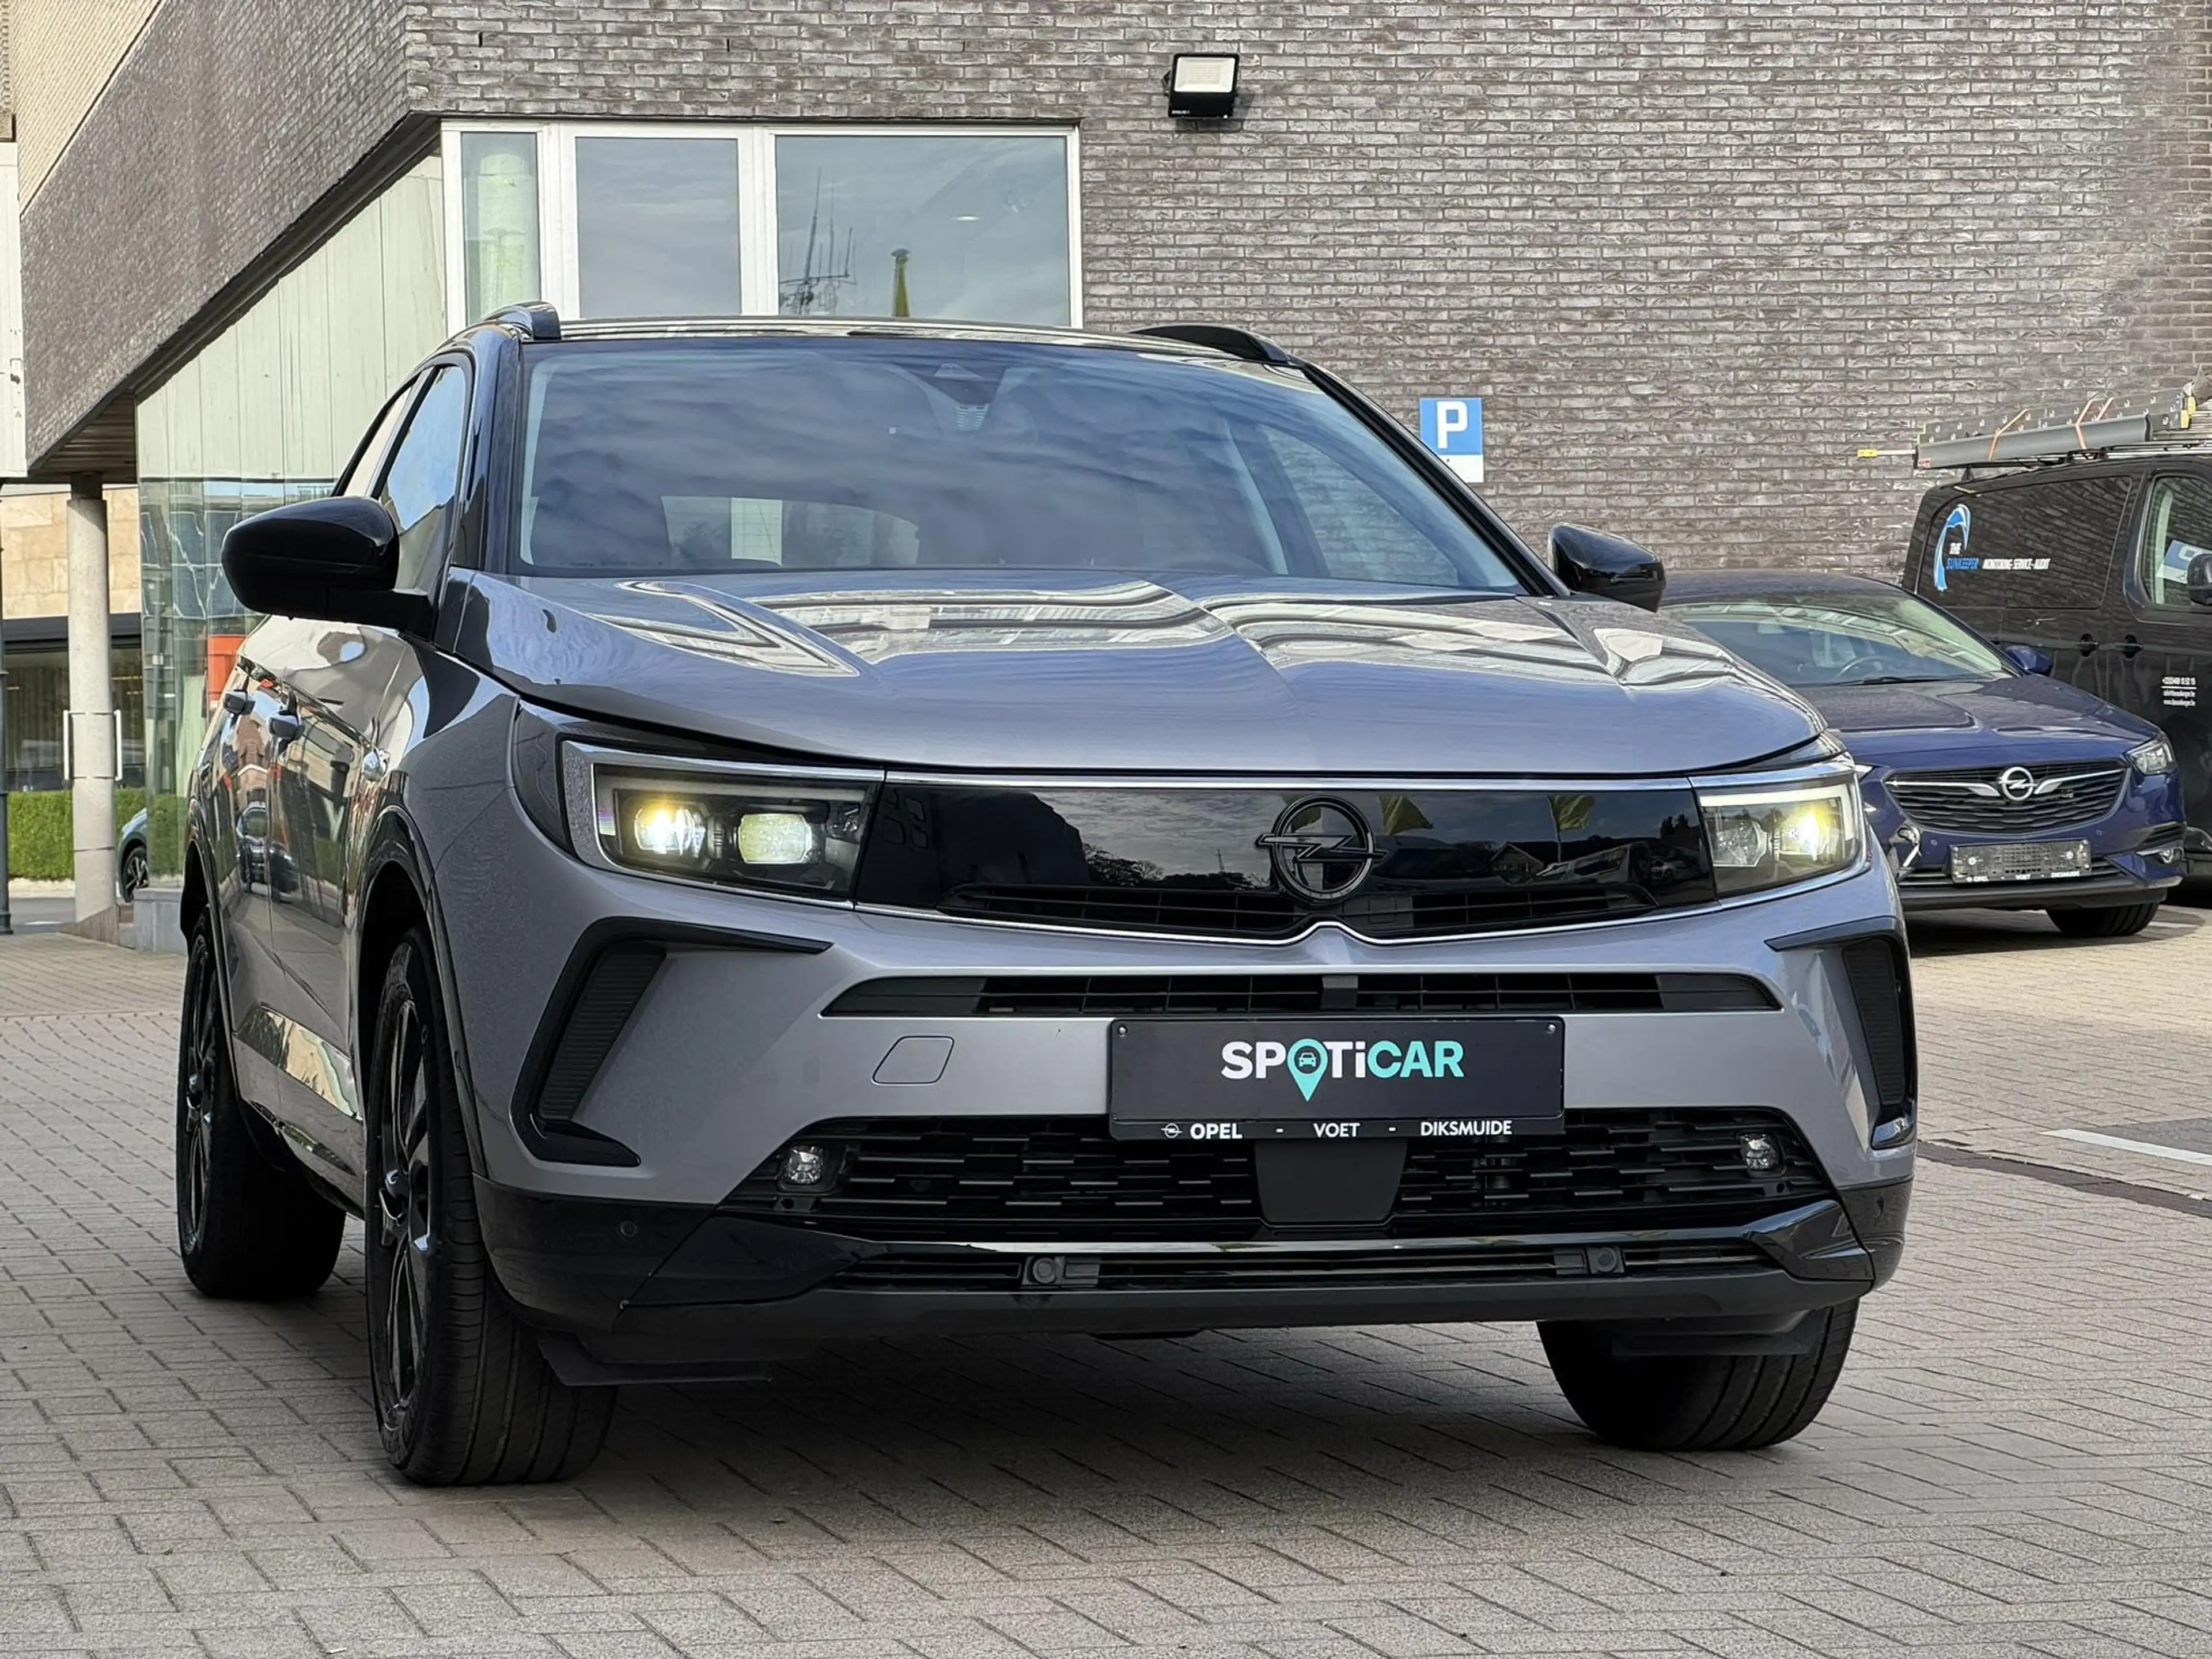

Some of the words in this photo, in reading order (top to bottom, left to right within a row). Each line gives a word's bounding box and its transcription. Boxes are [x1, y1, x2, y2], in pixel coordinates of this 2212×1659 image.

[1437, 401, 1467, 448] P
[1190, 1123, 1243, 1139] OPEL
[1313, 1123, 1360, 1137] VOET
[1421, 1120, 1512, 1135] DIKSMUIDE
